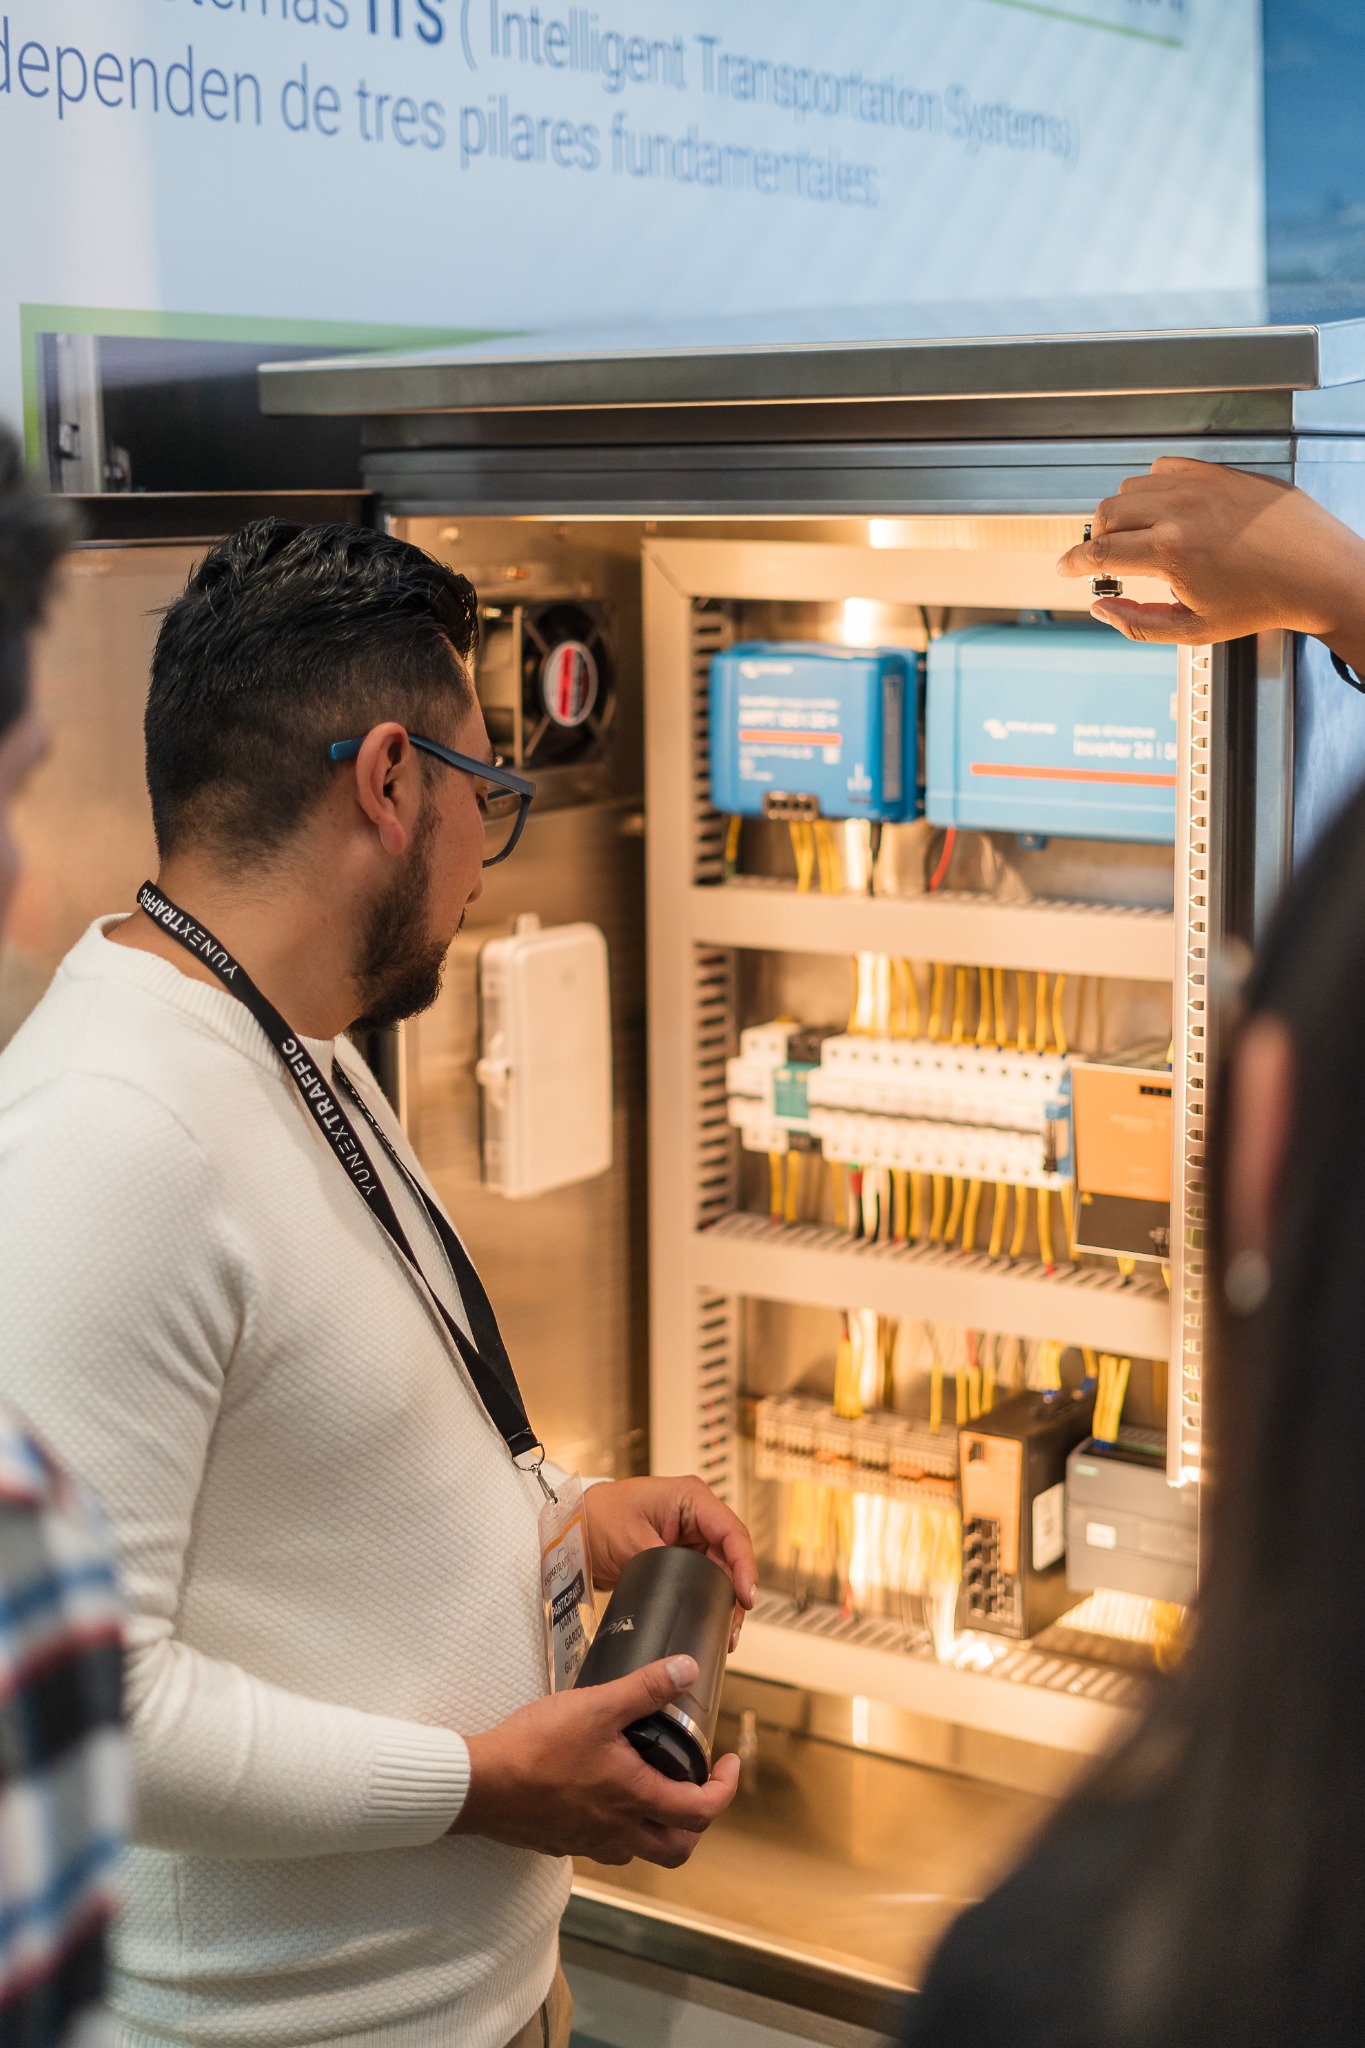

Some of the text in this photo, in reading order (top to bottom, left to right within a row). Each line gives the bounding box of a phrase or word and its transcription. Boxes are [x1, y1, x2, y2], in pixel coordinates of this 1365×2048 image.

[281, 62, 342, 138] de
[355, 79, 447, 150] tres
[459, 93, 601, 171] pilares
[694, 36, 944, 134] Transportation
